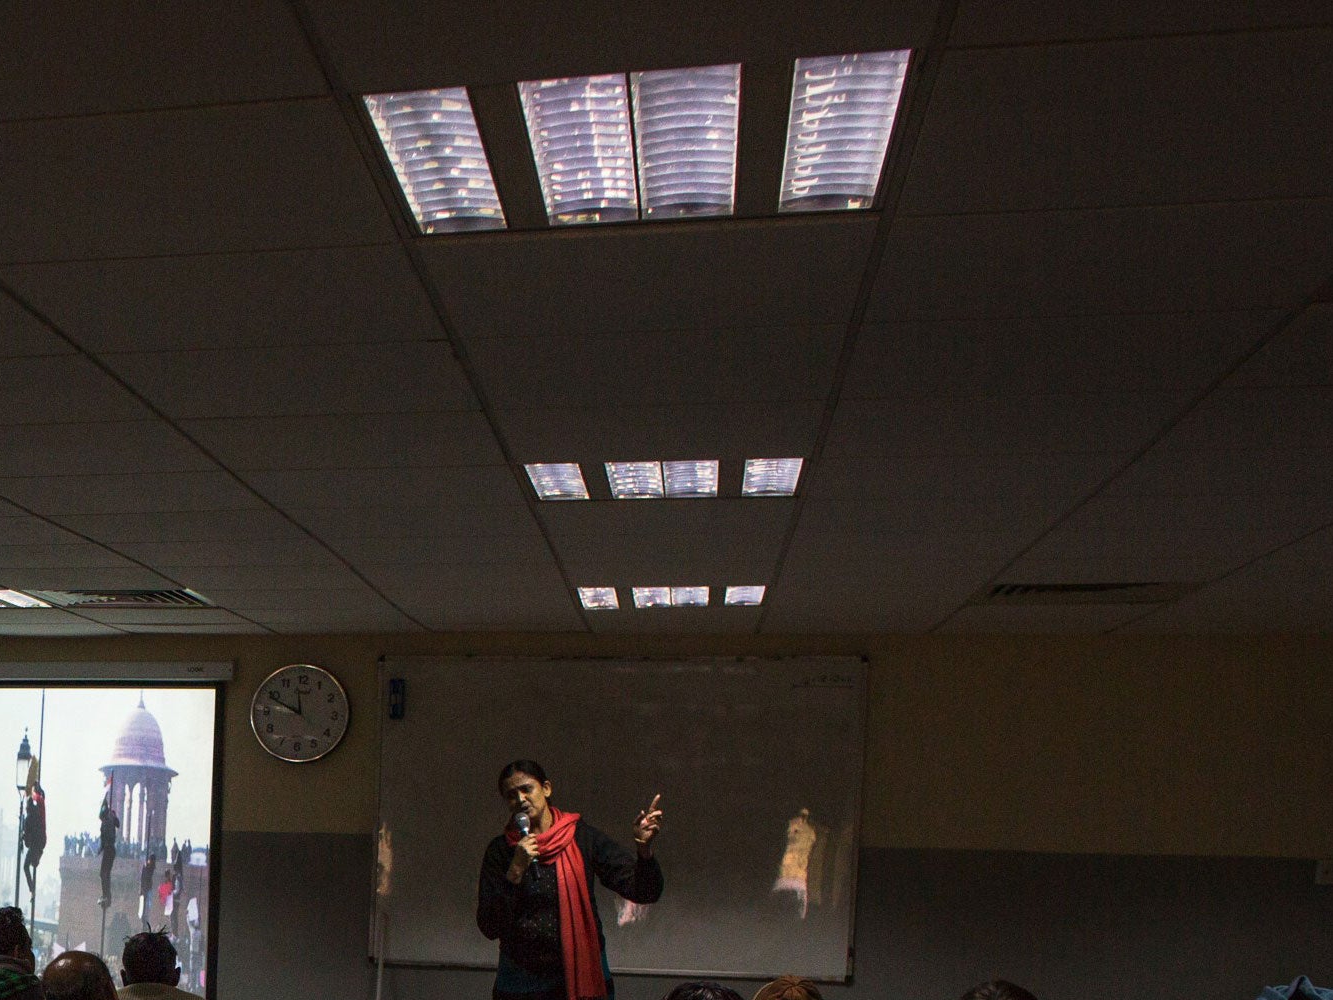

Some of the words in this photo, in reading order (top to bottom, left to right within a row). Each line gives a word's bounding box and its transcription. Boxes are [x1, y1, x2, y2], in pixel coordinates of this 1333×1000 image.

[282, 679, 290, 688] 11
[299, 675, 309, 685] 12
[317, 681, 322, 690] 1
[327, 693, 335, 703] 2
[263, 706, 270, 716] 9
[332, 711, 338, 720] 3
[266, 724, 274, 733] 8
[323, 728, 331, 737] 4
[279, 737, 285, 746] 7
[310, 739, 317, 748] 5
[294, 742, 301, 752] 6
